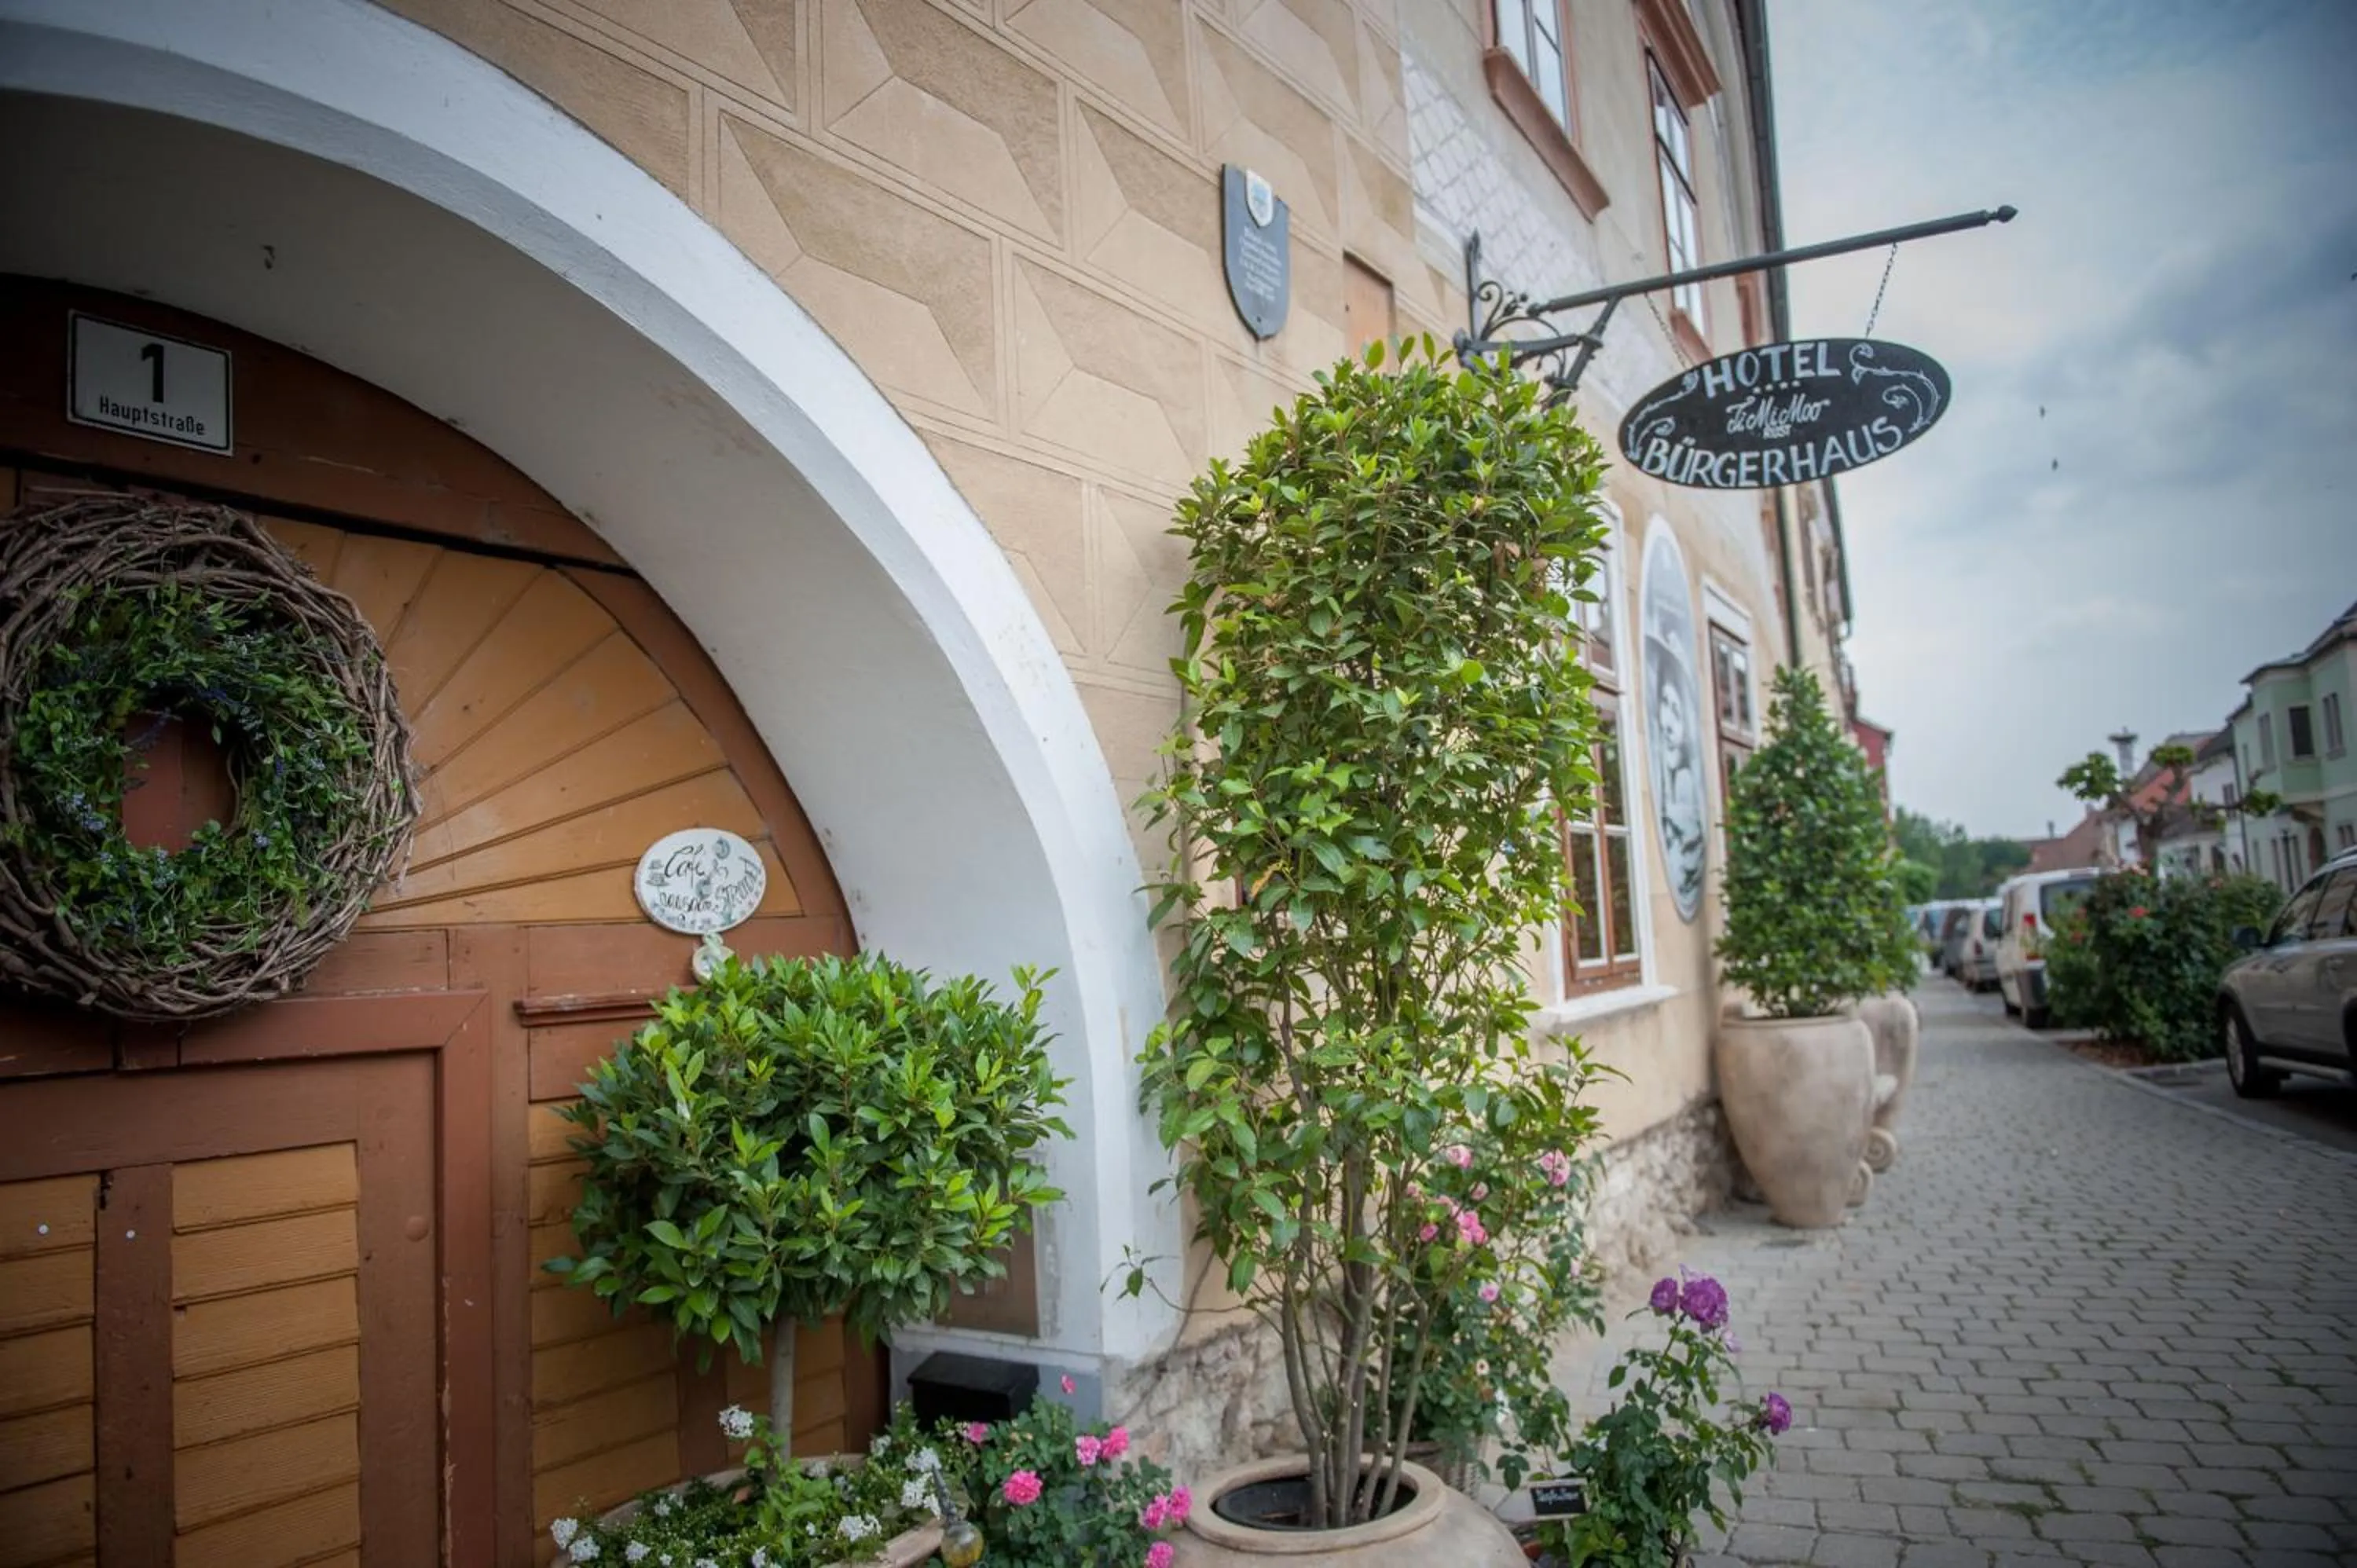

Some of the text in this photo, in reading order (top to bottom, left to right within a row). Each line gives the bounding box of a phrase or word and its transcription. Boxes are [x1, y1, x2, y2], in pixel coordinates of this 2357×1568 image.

[141, 342, 164, 404] 1
[1703, 341, 1842, 399] HOTEL
[99, 394, 206, 436] Hauptstraße
[1640, 416, 1903, 488] BÜRGERHAUS
